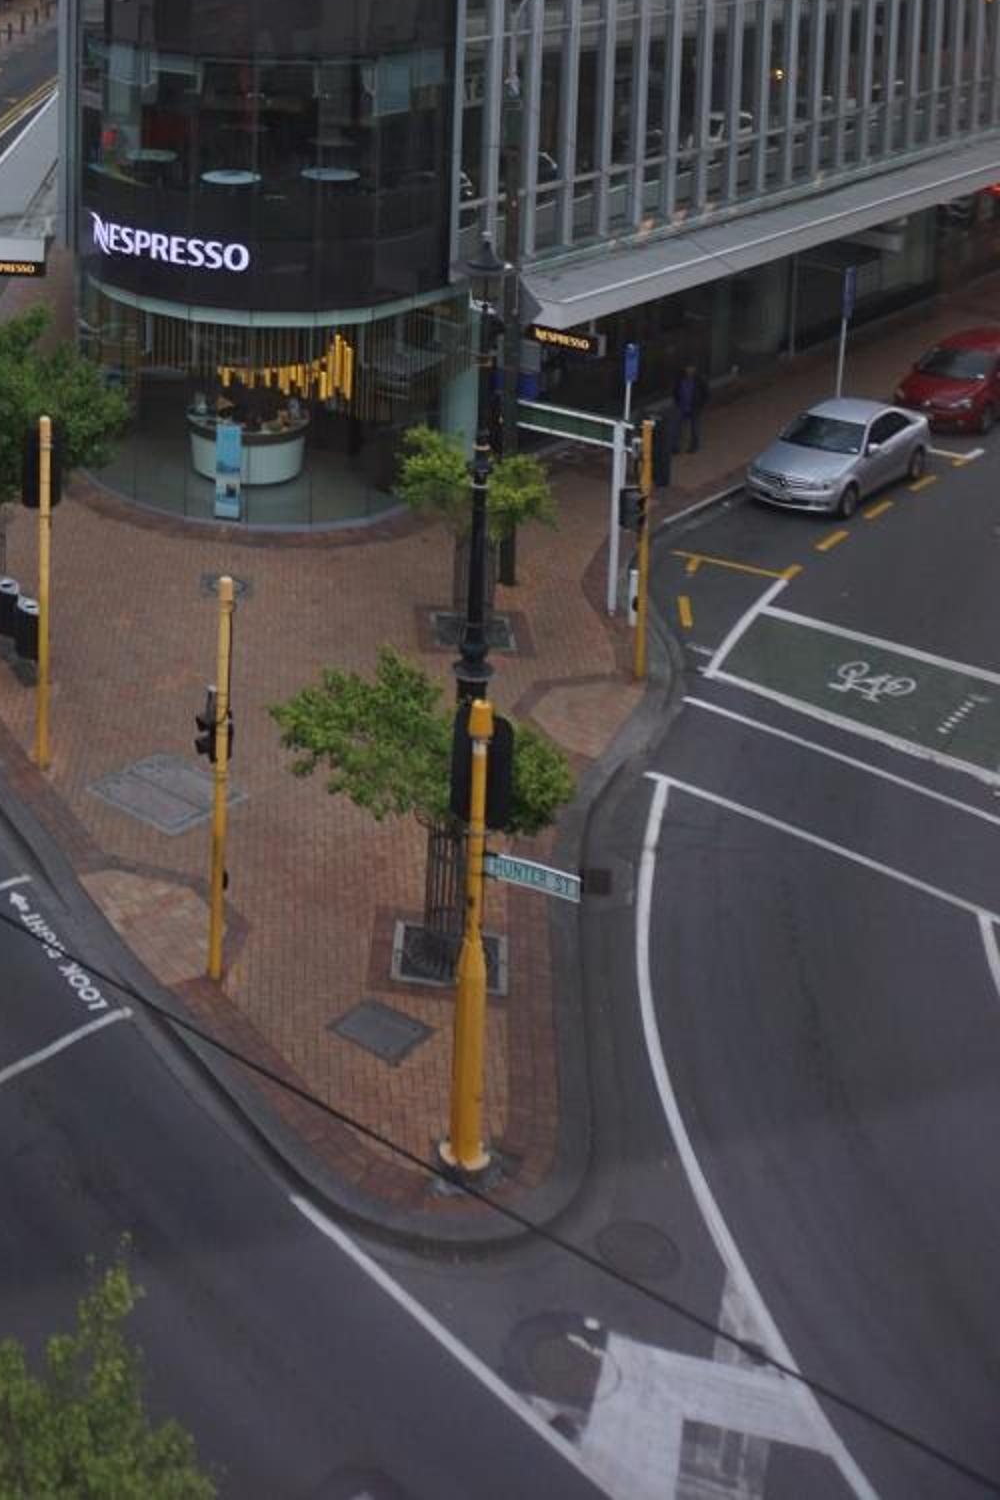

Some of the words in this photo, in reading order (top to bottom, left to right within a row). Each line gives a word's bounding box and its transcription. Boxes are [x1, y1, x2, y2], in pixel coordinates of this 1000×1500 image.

[89, 211, 250, 271] NESPRESSO
[535, 327, 590, 350] NESPRESSO
[493, 857, 546, 886] HUNTER
[553, 876, 570, 894] ST
[59, 962, 108, 1011] LOOK
